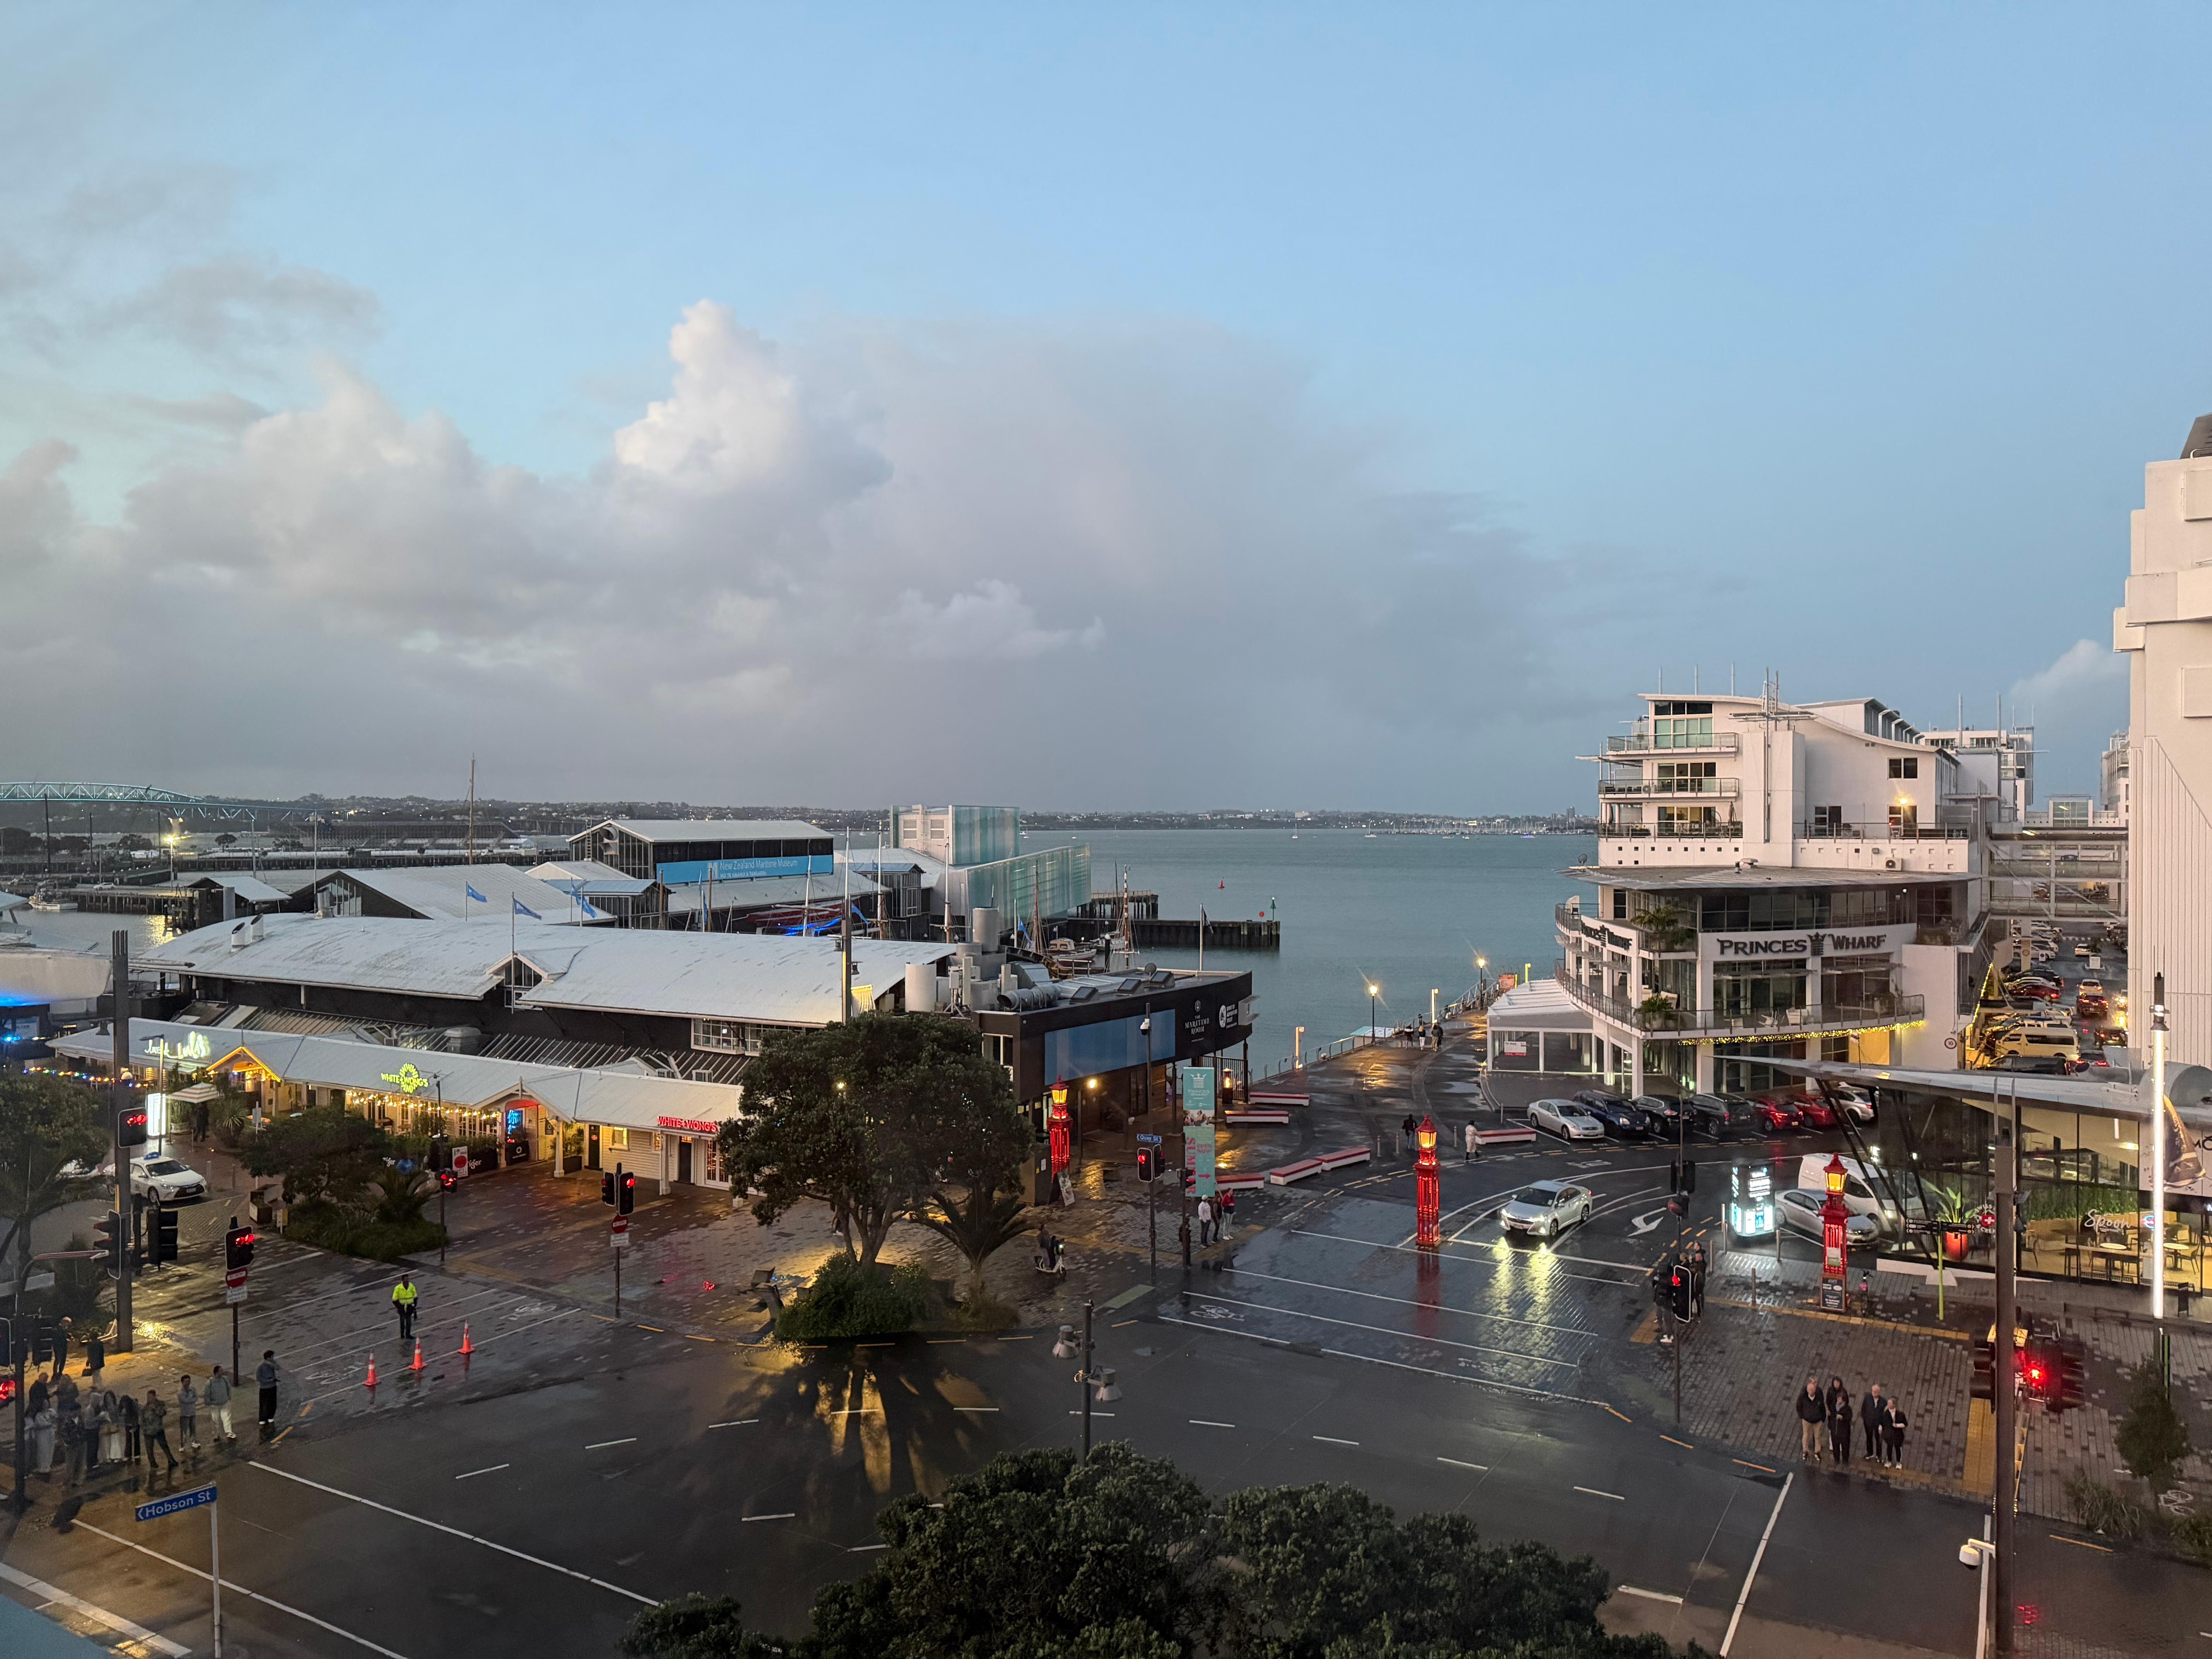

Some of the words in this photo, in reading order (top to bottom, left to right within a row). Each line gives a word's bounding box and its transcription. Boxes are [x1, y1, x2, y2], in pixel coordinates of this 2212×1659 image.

[720, 861, 732, 870] New
[733, 860, 754, 869] Zealand
[756, 860, 777, 868] Maritime
[1717, 938, 1807, 955] PRINCES
[1828, 933, 1886, 950] WHARF
[1185, 1018, 1210, 1029] MARITIME
[1191, 1025, 1204, 1034] ROOM
[468, 1159, 482, 1169] iger
[2084, 1209, 2131, 1234] Spoon
[146, 1498, 194, 1517] Hobson
[198, 1490, 211, 1502] St
